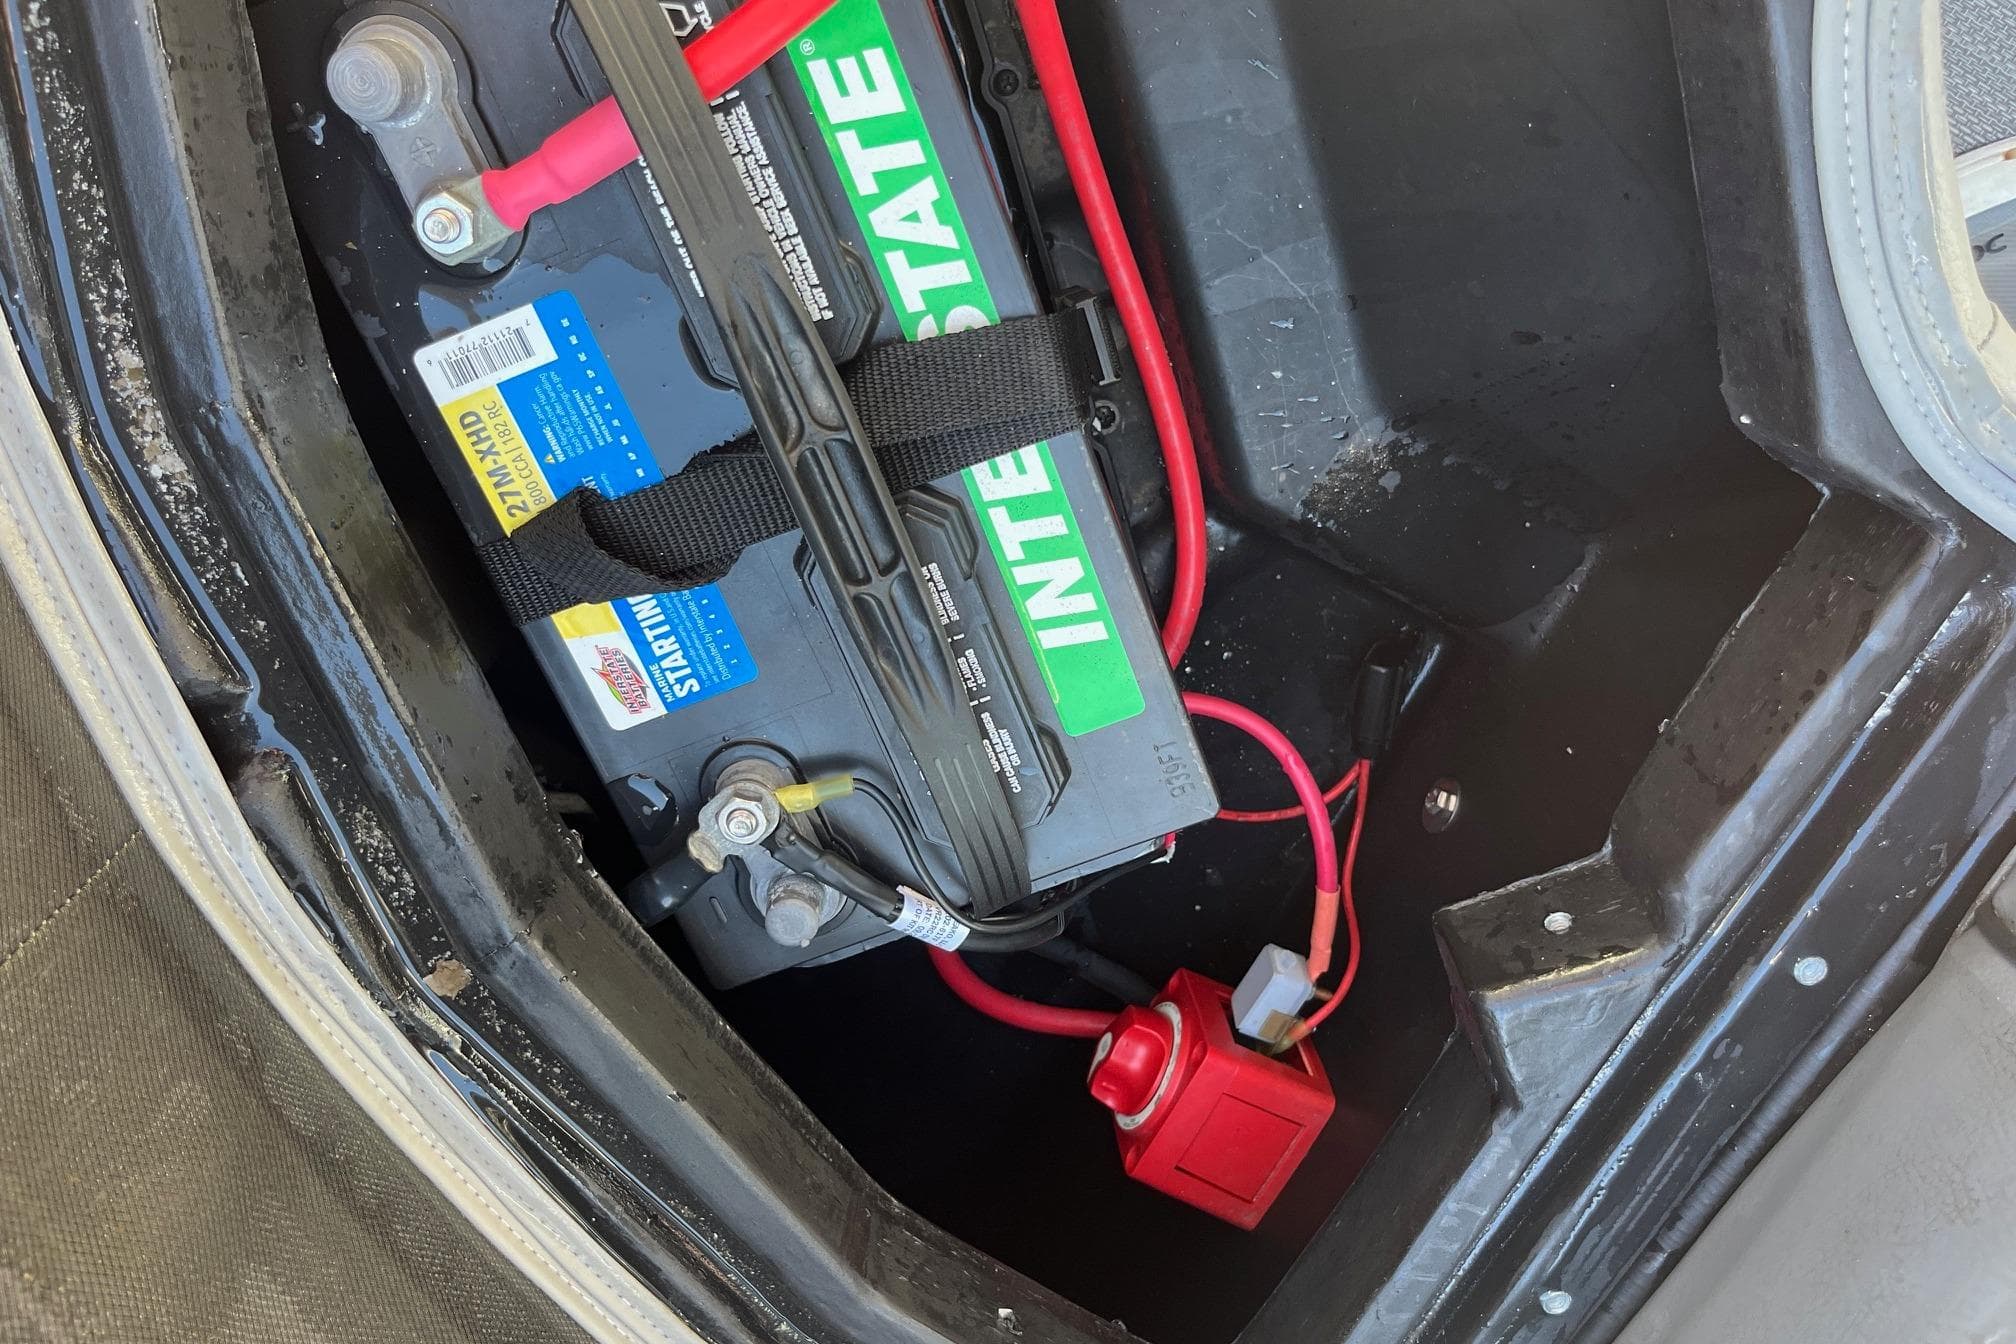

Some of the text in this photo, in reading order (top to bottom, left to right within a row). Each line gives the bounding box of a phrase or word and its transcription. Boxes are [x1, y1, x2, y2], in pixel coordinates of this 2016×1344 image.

[744, 153, 770, 198] OWNERS
[761, 166, 787, 209] SERVICE
[763, 197, 787, 240] VEHICLE
[779, 207, 799, 236] SEEK
[790, 233, 820, 287] AVAILABLE
[787, 251, 822, 322] INSTRUCTIONS
[812, 285, 829, 308] NOT
[821, 307, 834, 320] IF
[444, 339, 480, 361] 77011
[479, 325, 513, 345] 21112
[805, 47, 1110, 649] INTESTATE
[482, 399, 502, 420] RC
[536, 371, 585, 454] Wash hands after handling
[542, 403, 570, 445] Reproductive
[571, 387, 606, 446] RECHARGE MONTHLY
[592, 410, 604, 425] NOT
[492, 419, 515, 445] 182
[529, 401, 566, 462] WARNING: Cancer
[599, 424, 614, 443] WHEN
[455, 407, 531, 520] 27M-XHD
[510, 452, 534, 481] CCA
[564, 444, 576, 458] and
[626, 450, 637, 461] AP
[524, 479, 548, 507] 800
[927, 560, 947, 590] BURNS
[685, 599, 708, 633] Interstate
[939, 588, 960, 621] SEVERE
[686, 645, 699, 662] under
[701, 631, 715, 643] by
[695, 660, 710, 681] replace
[705, 641, 732, 680] Distributed
[956, 655, 977, 688] FLAMES
[963, 647, 986, 684] SMOKING
[598, 646, 639, 715] INTERSTATE
[611, 647, 647, 709] BATTERIES
[648, 661, 675, 703] MARINE
[979, 710, 1022, 793] CAN CAUSE BLINDNESS
[997, 726, 1021, 767] OR INJURY
